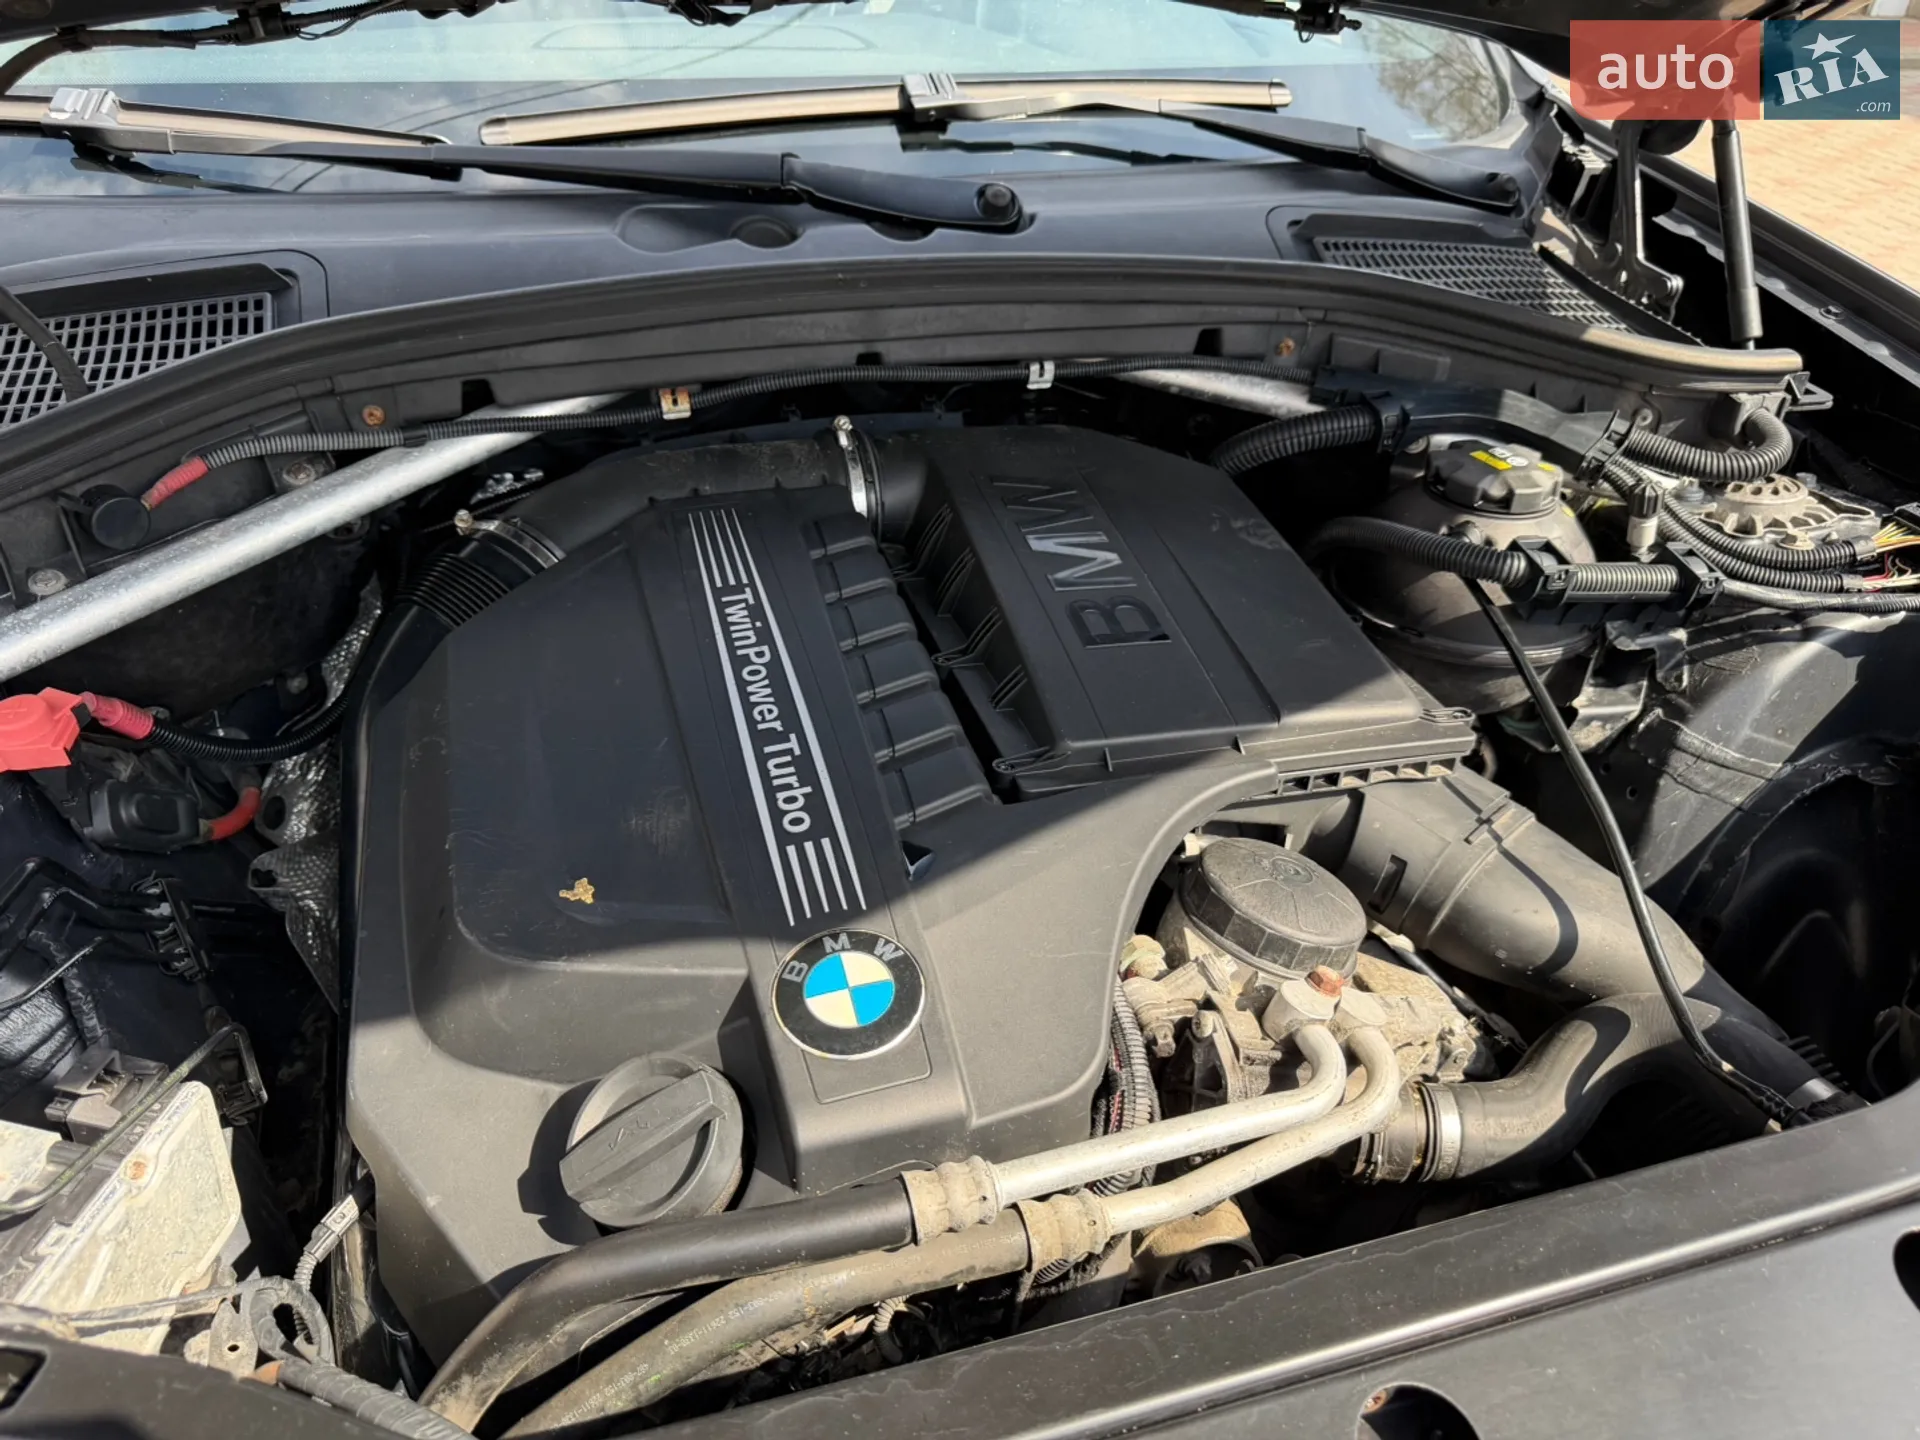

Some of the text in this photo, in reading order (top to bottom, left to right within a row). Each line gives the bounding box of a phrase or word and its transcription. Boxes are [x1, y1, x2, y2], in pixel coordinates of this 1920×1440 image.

[990, 475, 1172, 648] BMW
[721, 587, 812, 833] TwinPower Turbo
[782, 932, 904, 983] BMW
